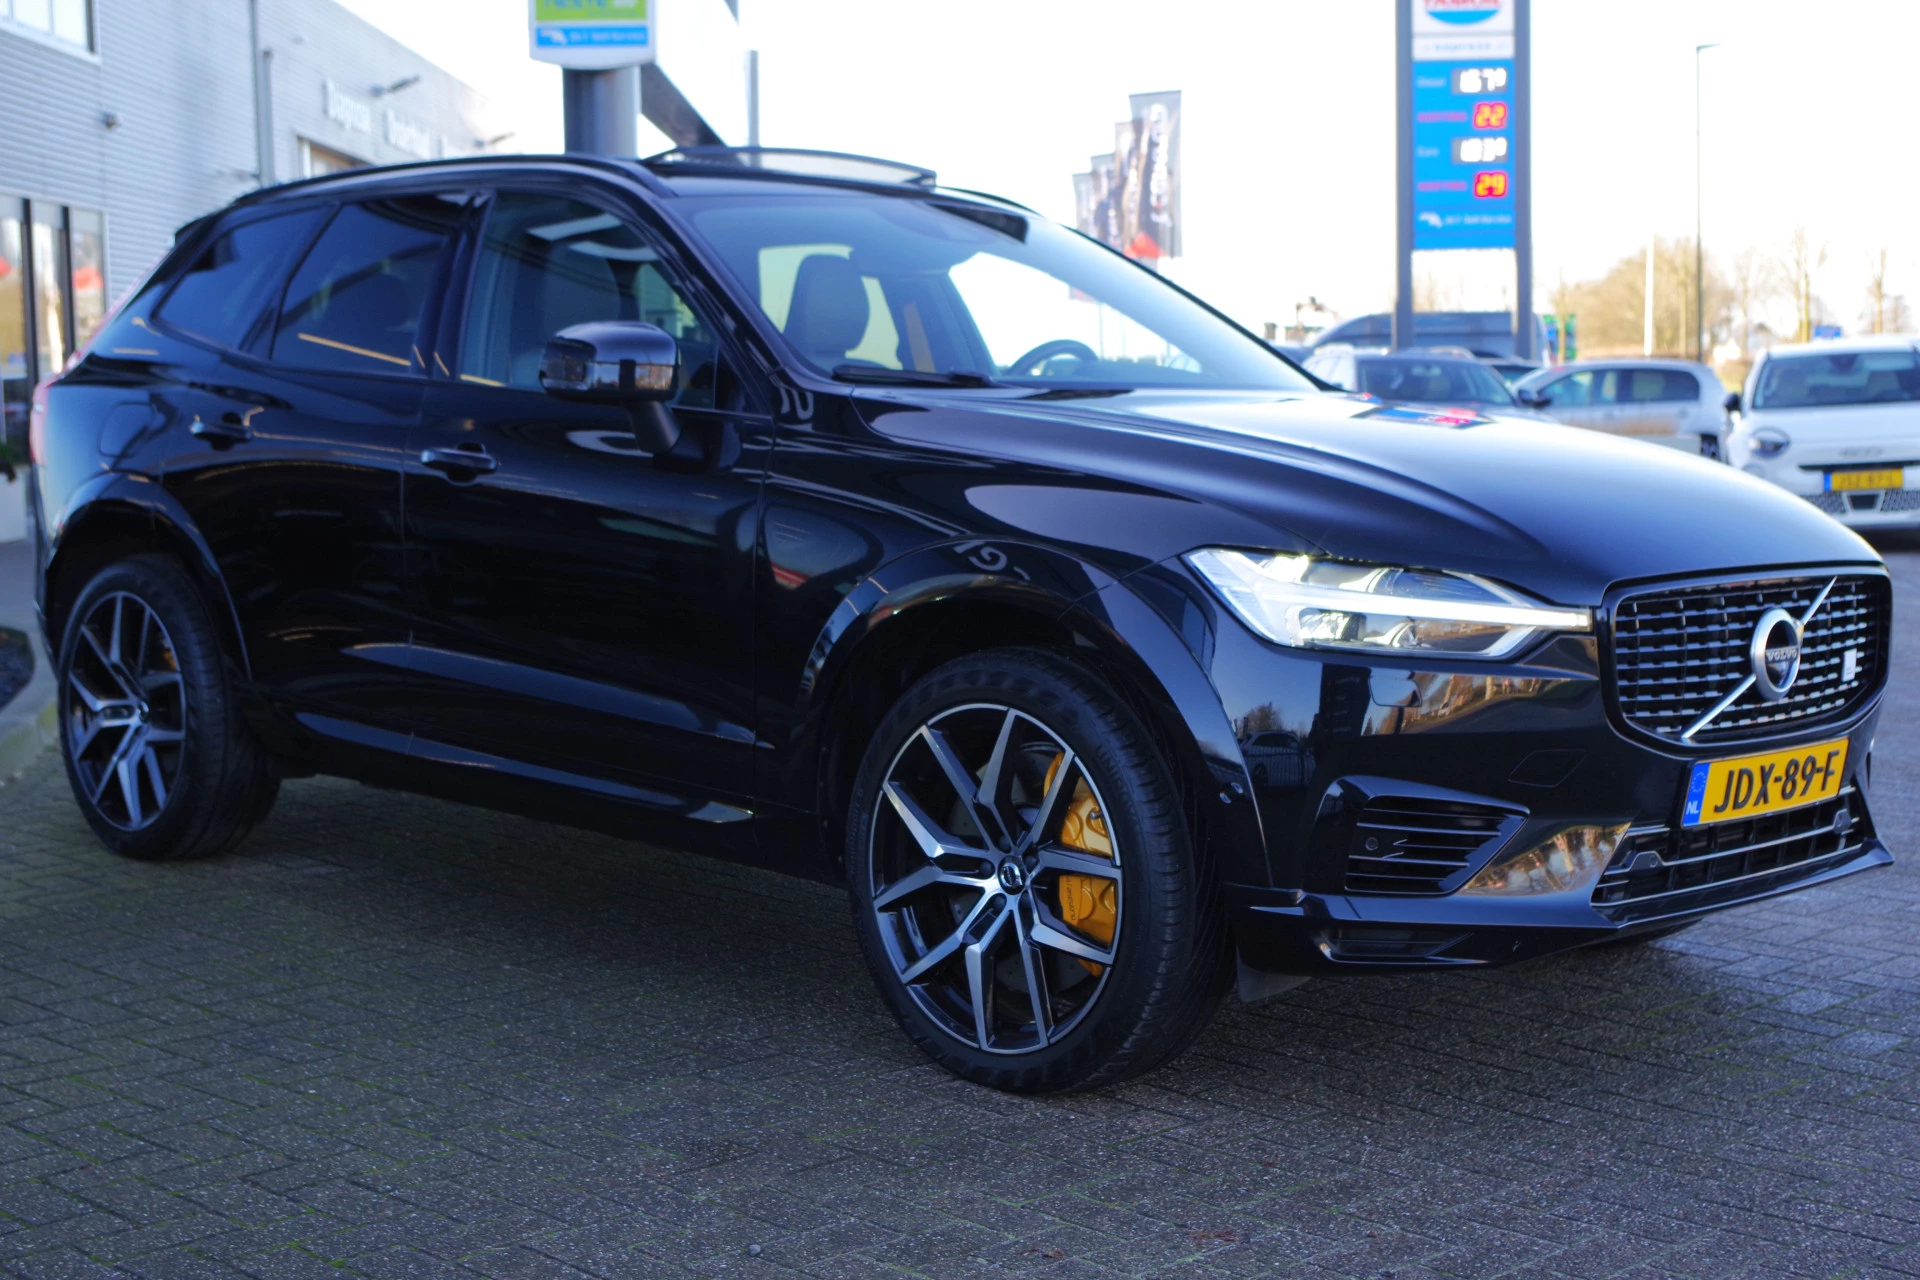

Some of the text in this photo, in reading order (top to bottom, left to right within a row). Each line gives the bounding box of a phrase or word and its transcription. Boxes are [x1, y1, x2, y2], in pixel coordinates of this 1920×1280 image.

[1766, 648, 1798, 662] VOLVO
[1713, 750, 1840, 813] JDX-89-F
[1686, 800, 1699, 815] NL
